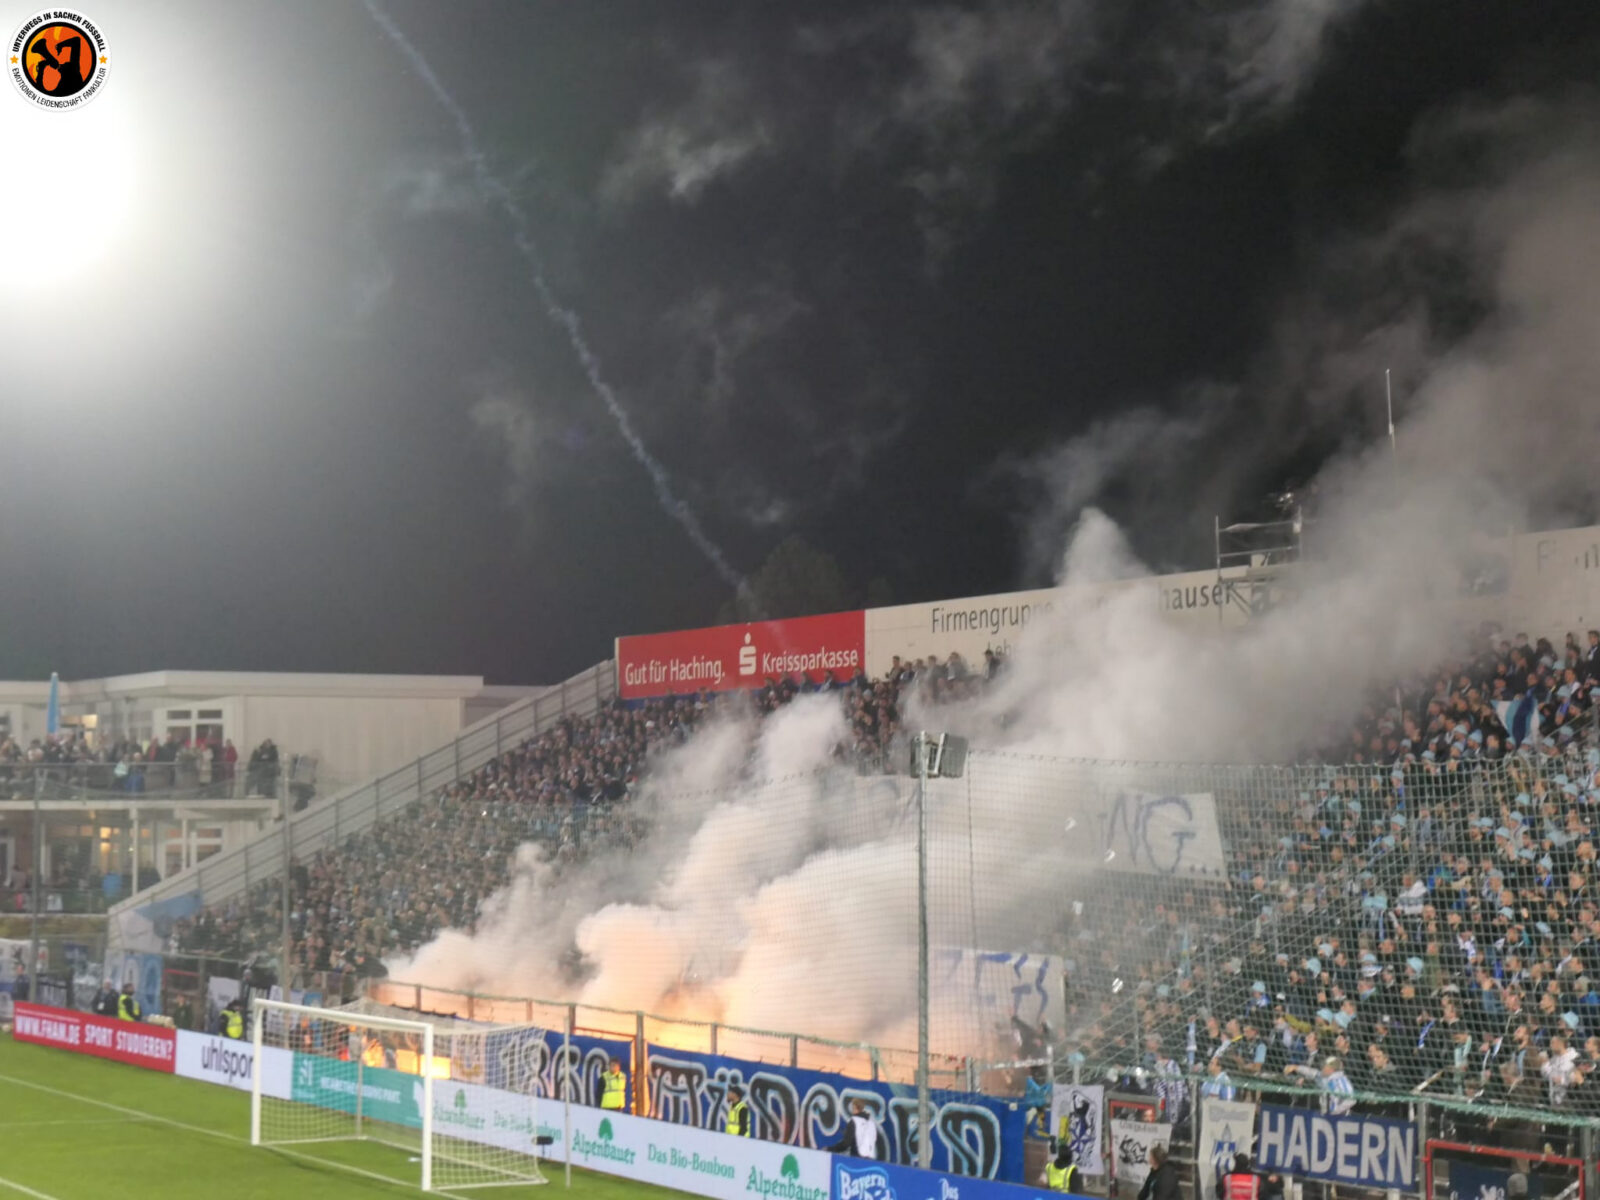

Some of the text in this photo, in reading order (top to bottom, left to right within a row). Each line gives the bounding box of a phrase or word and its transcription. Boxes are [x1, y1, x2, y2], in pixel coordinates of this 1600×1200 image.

[625, 654, 726, 686] Gut für Haching.
[762, 647, 859, 673] Kreissparkasse
[84, 1024, 113, 1047] SPORT
[116, 1030, 174, 1060] STUDIEREN?
[202, 1038, 254, 1083] uhlspor
[572, 1129, 636, 1165] Alpenbauer
[647, 1143, 736, 1179] Das Bio-Bonbon
[1258, 1110, 1415, 1187] HADERN
[746, 1165, 829, 1200] Alpenbauer
[839, 1169, 887, 1200] Bayern
